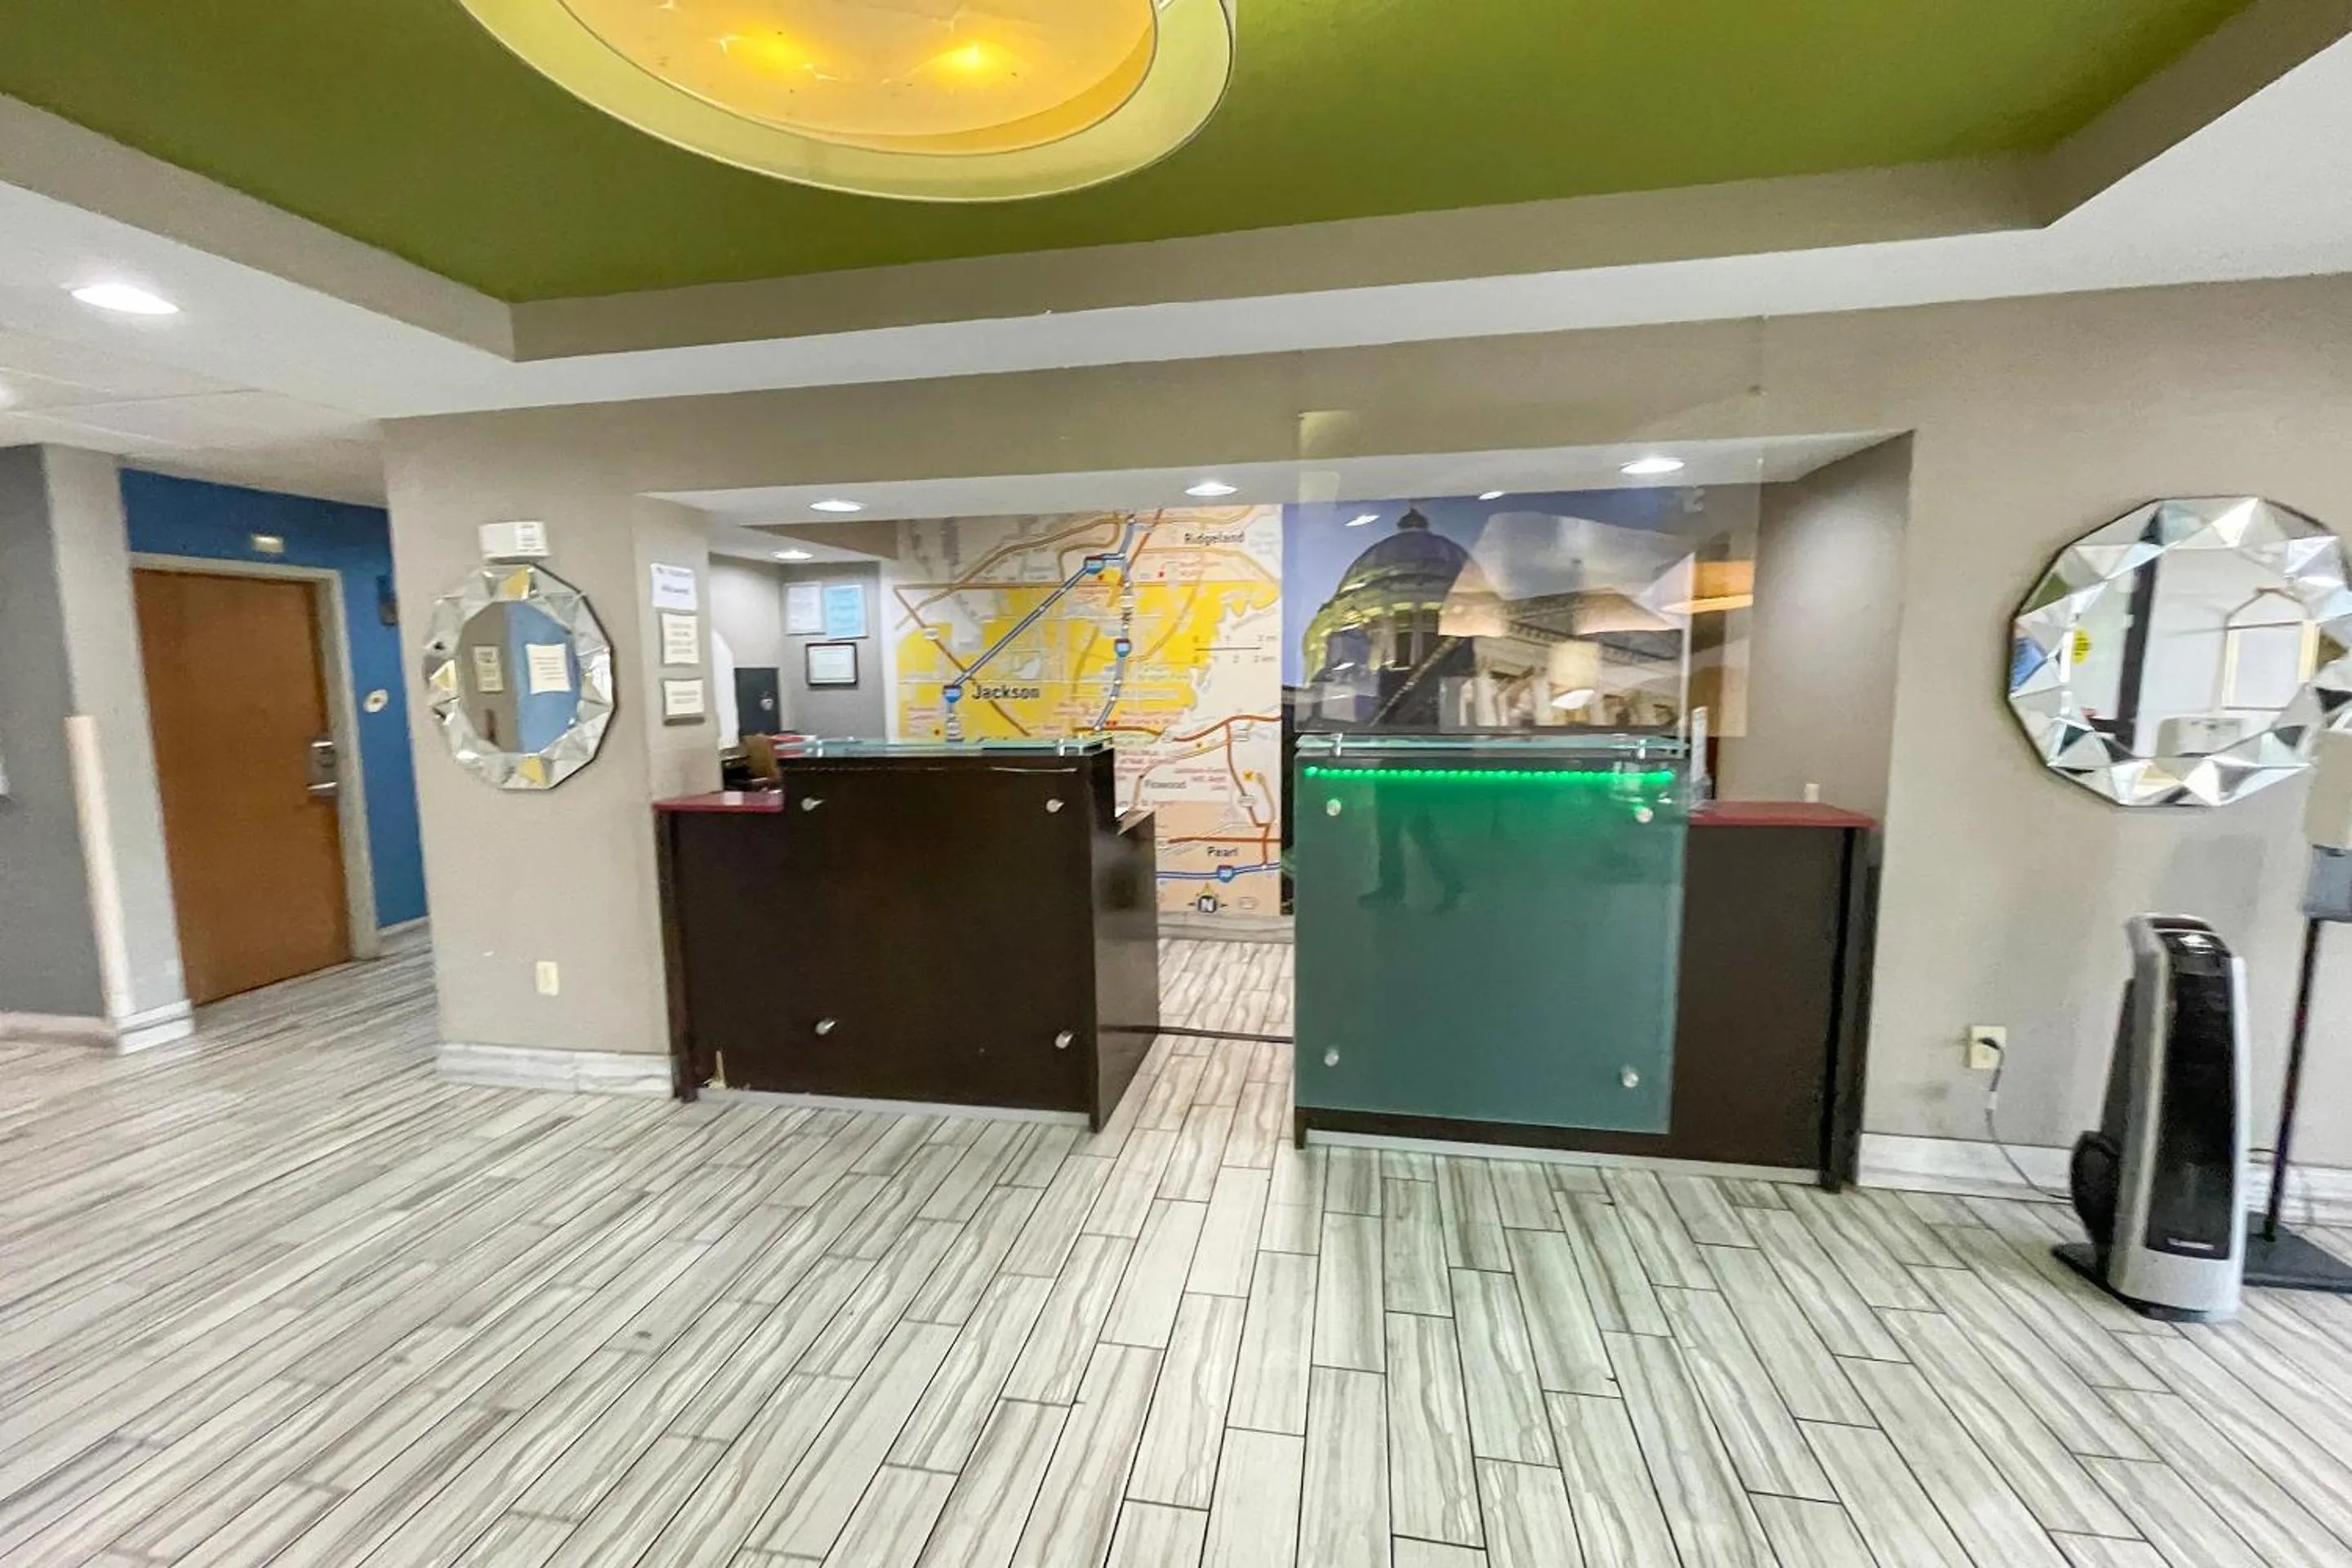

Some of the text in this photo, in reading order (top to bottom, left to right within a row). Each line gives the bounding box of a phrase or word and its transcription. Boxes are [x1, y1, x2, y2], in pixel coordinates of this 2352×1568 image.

[1184, 531, 1245, 546] Ridgeland
[972, 684, 1040, 699] Jackson
[1207, 846, 1238, 857] Pearl
